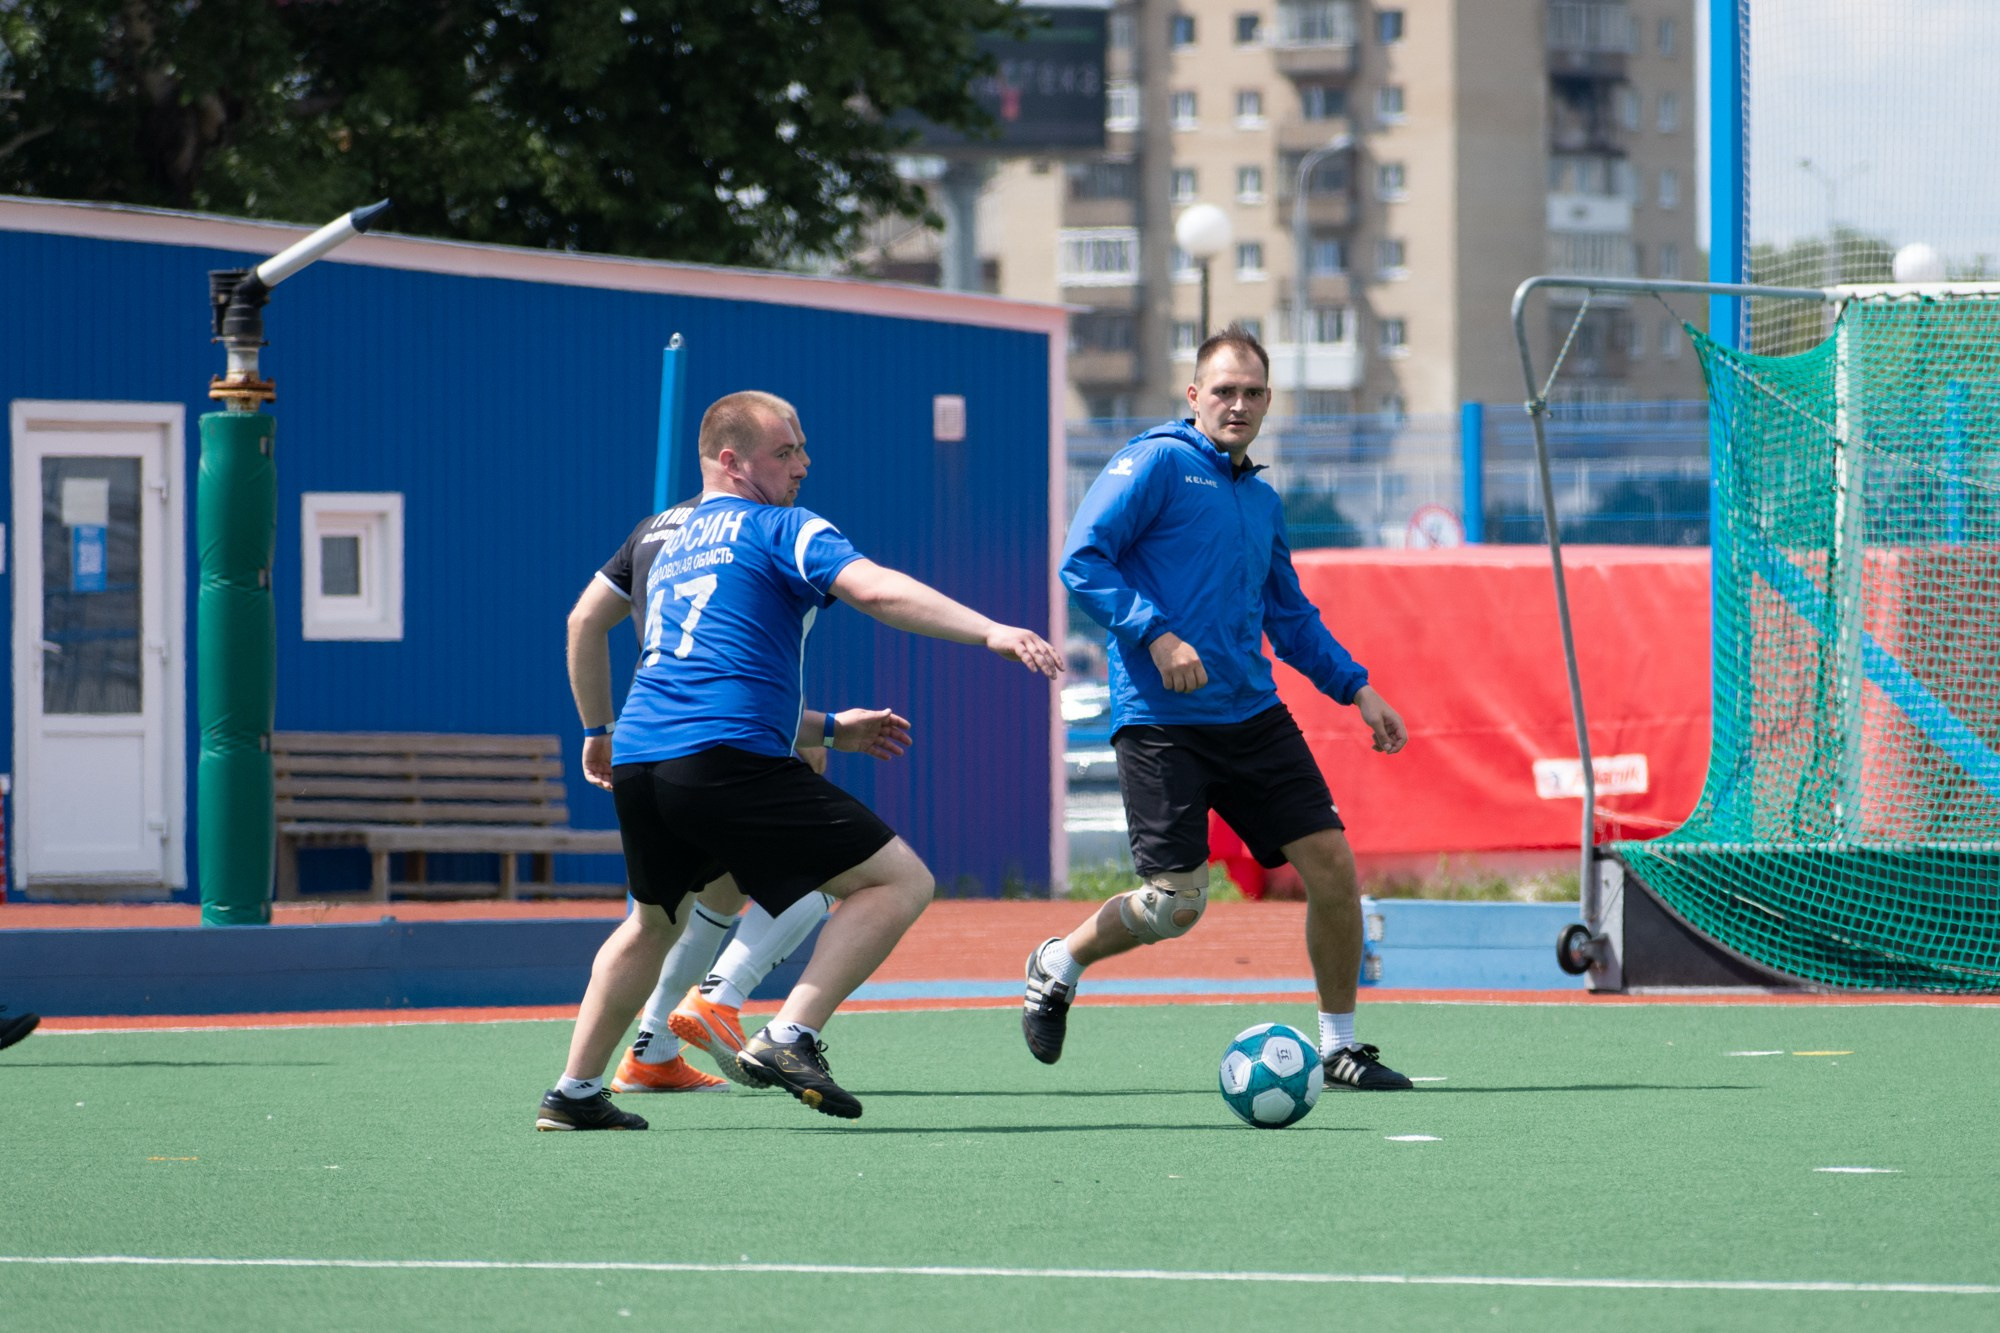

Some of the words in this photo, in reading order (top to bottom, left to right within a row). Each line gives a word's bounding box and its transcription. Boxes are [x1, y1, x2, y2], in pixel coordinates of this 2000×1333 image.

[1185, 475, 1218, 489] KELME
[693, 547, 735, 570] ОБЛАСТЬ
[645, 574, 718, 668] 17
